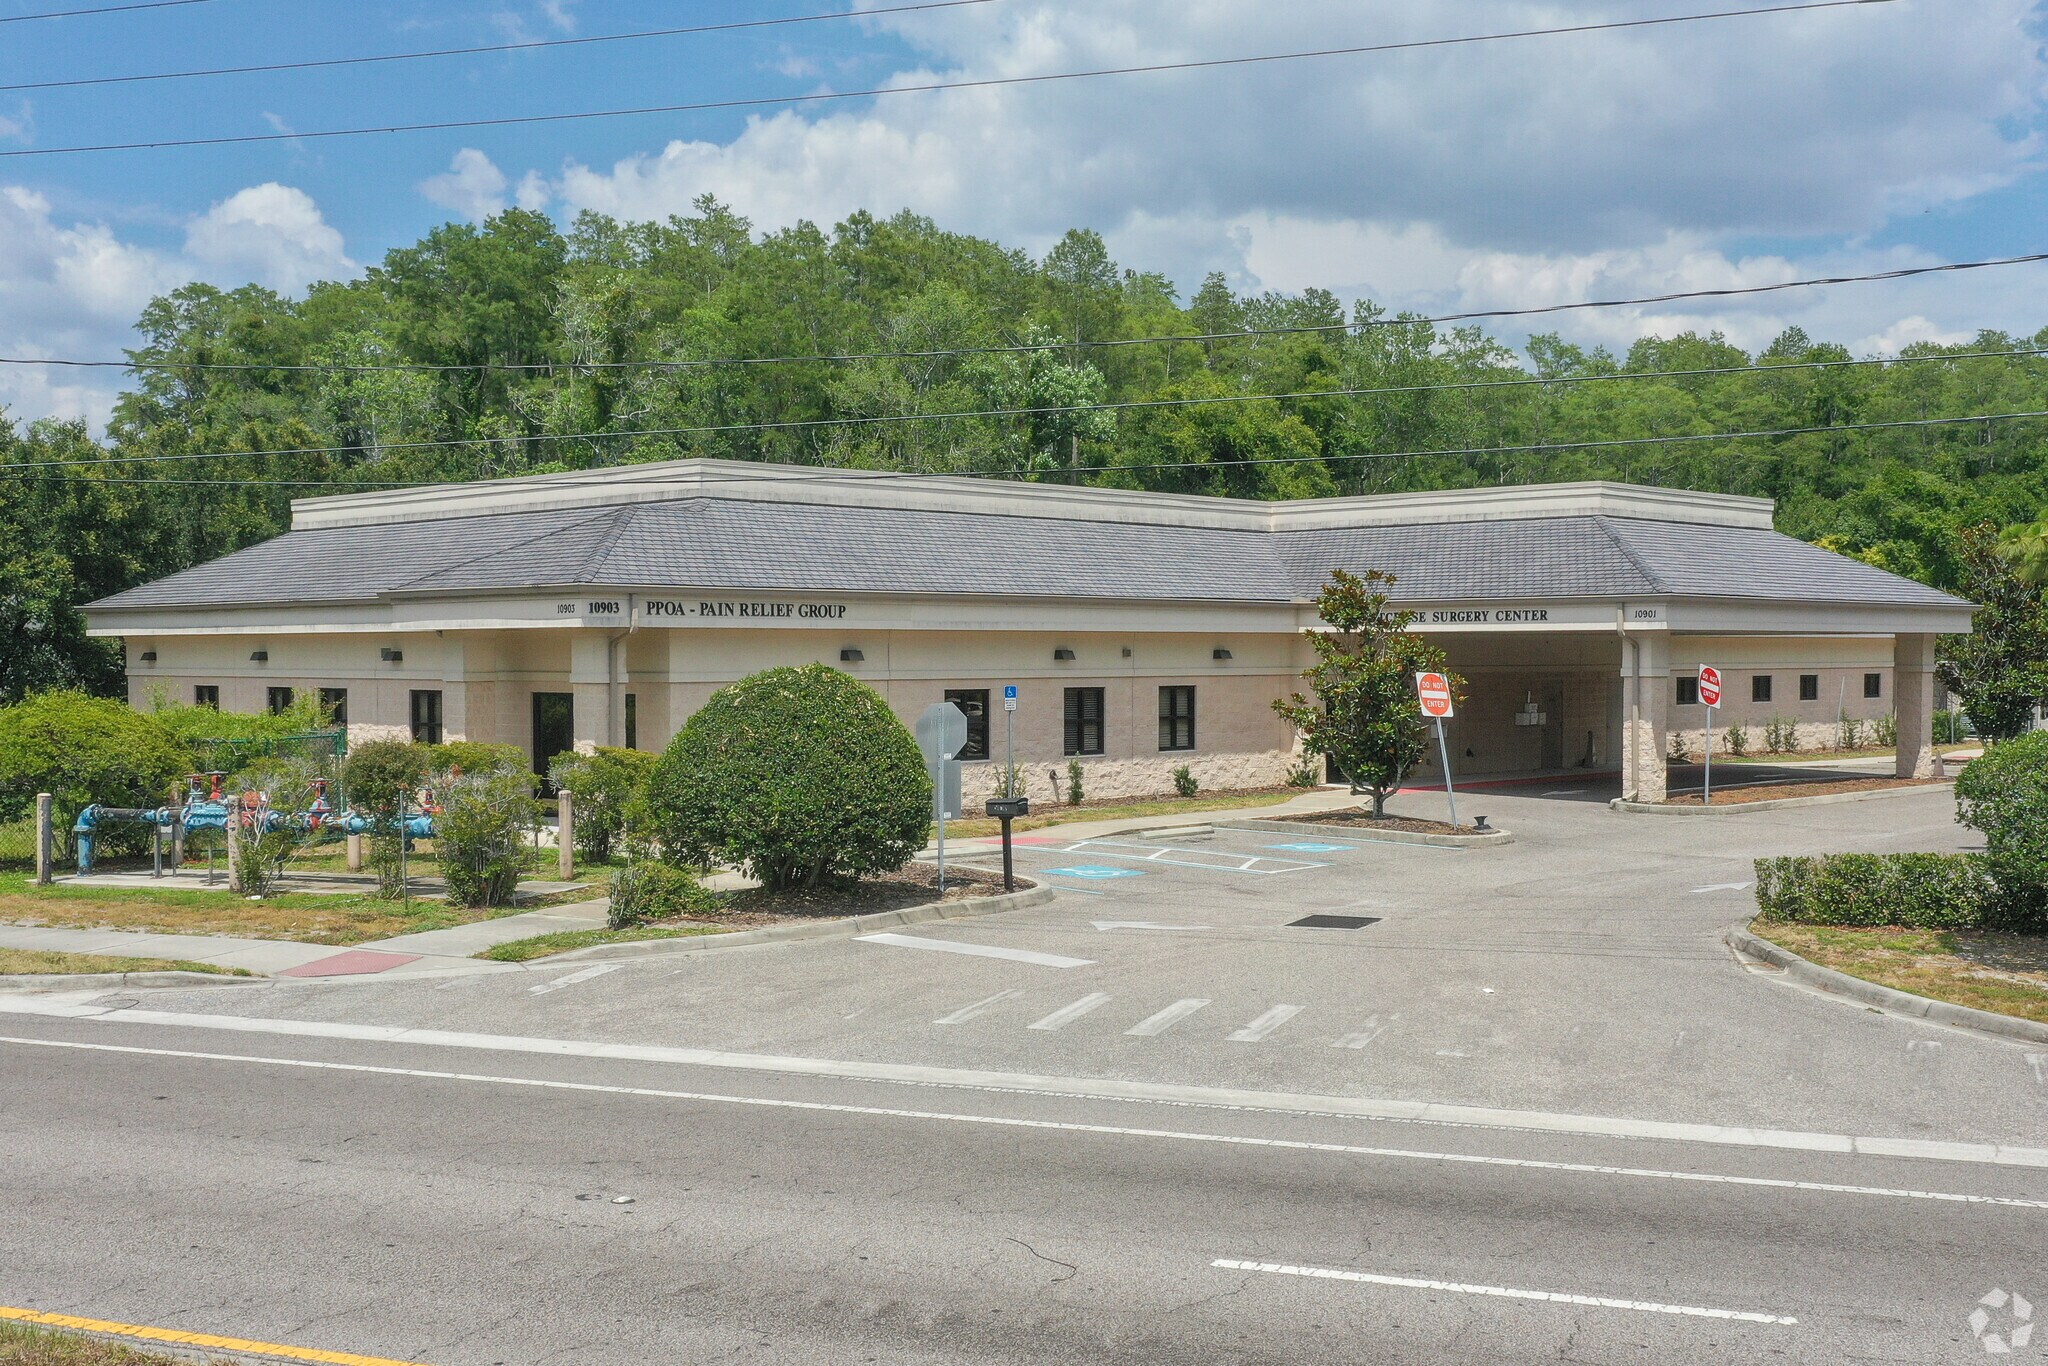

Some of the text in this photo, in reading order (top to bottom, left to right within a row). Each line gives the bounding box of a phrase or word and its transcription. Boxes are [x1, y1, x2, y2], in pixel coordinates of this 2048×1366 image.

[557, 604, 575, 614] 10903
[589, 602, 620, 614] 10903
[646, 601, 686, 616] PPOA
[699, 602, 735, 617] PAIN
[739, 603, 795, 618] RELIEF
[798, 603, 847, 619] GROUP
[1432, 611, 1489, 622] SURGERY
[1495, 610, 1548, 621] CENTER
[1634, 609, 1657, 619] 10901
[1702, 672, 1718, 684] DO NOT
[1703, 689, 1716, 700] ENTER
[1427, 700, 1445, 708] ENTER
